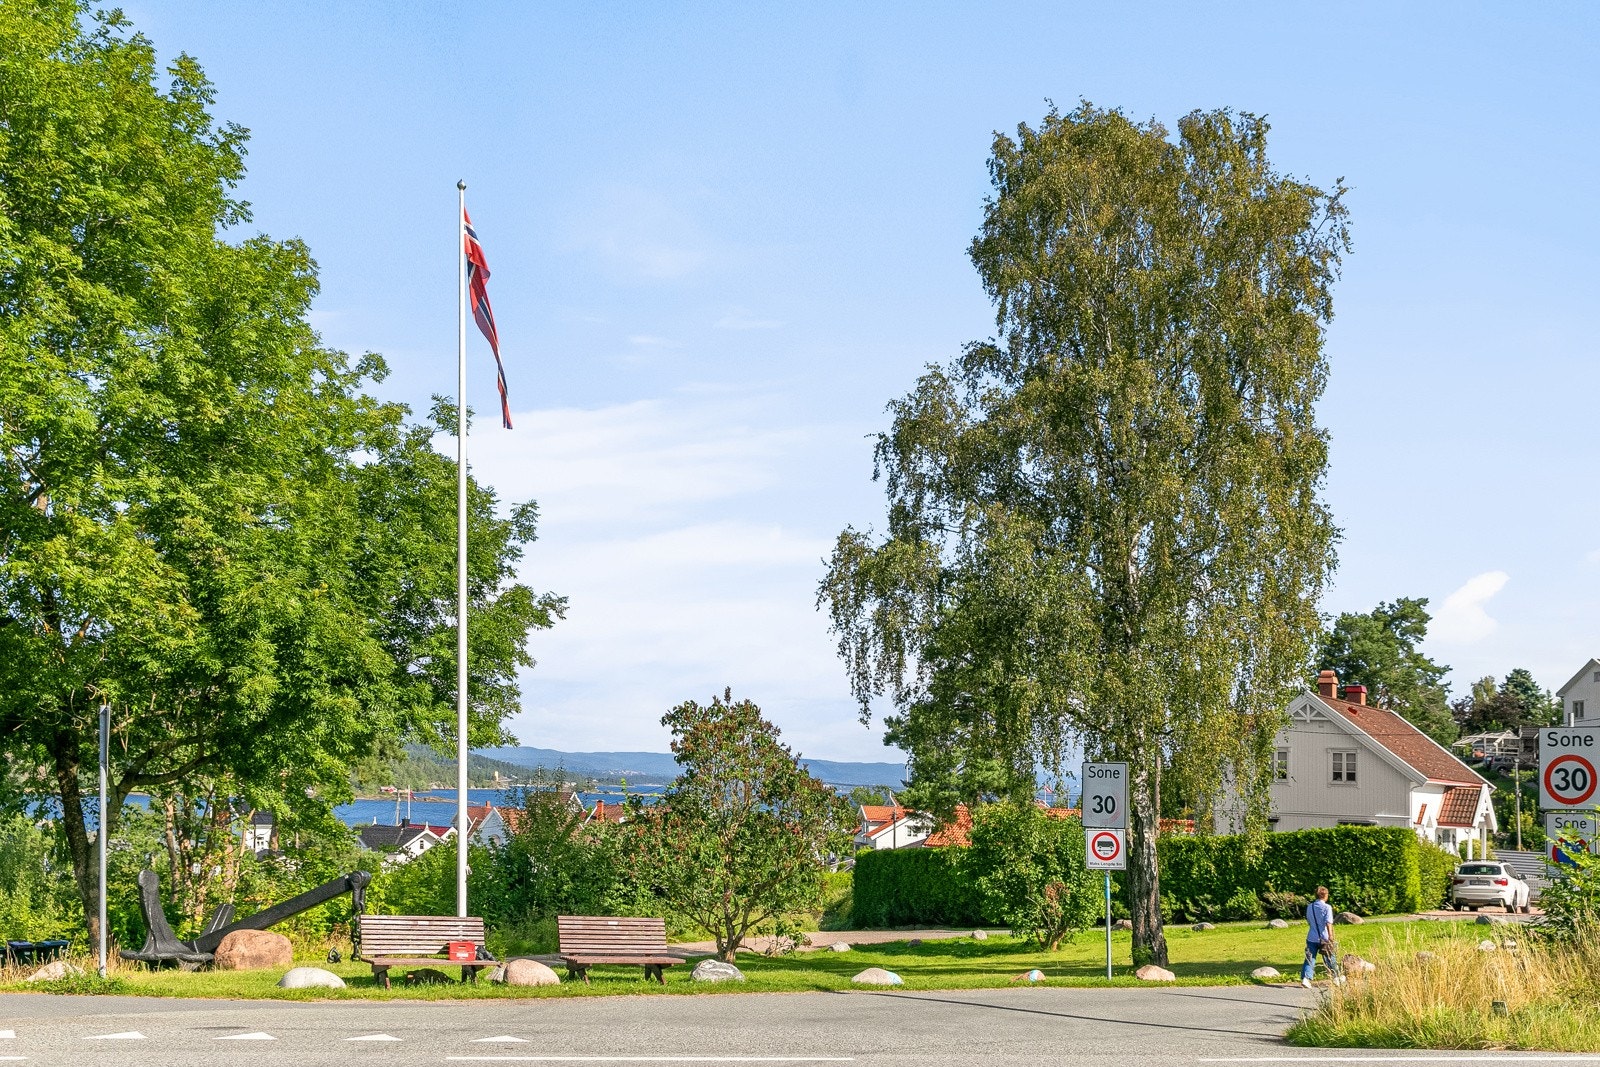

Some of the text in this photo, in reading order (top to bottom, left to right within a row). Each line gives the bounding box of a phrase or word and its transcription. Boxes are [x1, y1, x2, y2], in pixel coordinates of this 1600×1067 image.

[1547, 731, 1594, 747] Sone
[1088, 765, 1120, 779] Sone
[1554, 767, 1588, 792] 30
[1092, 794, 1116, 814] 30
